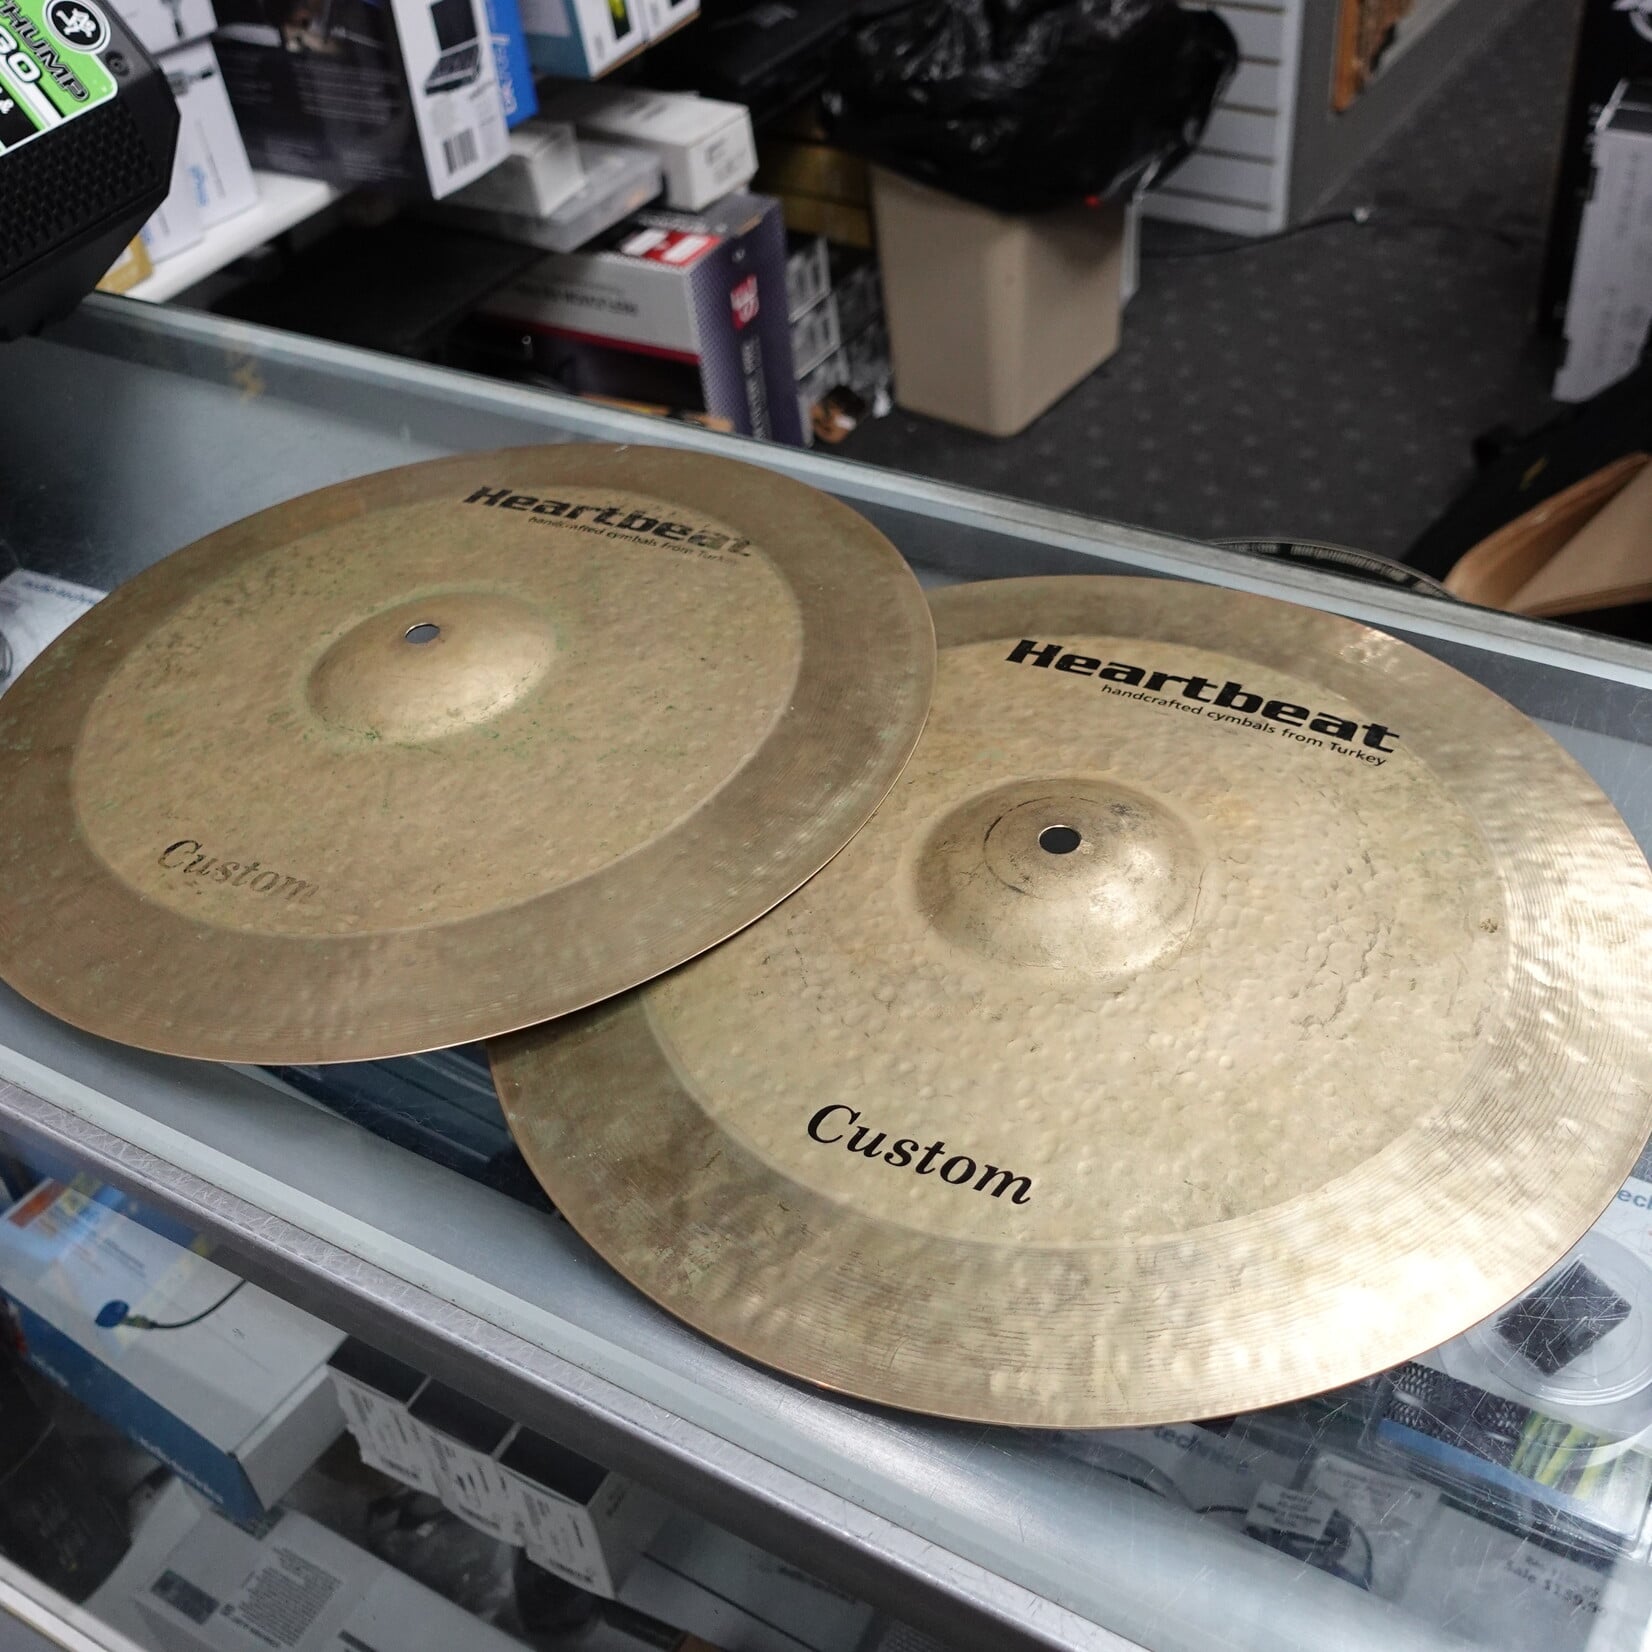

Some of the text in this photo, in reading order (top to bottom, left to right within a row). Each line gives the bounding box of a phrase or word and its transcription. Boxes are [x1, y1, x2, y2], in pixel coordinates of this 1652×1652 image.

[0, 0, 89, 102] HUMP
[463, 486, 751, 557] Heartbeat
[1006, 639, 1400, 753] Heartbeat
[1101, 684, 1387, 767] handcrafted cymbals from Turkey
[157, 839, 320, 901] Custom
[807, 1104, 1032, 1205] Custom
